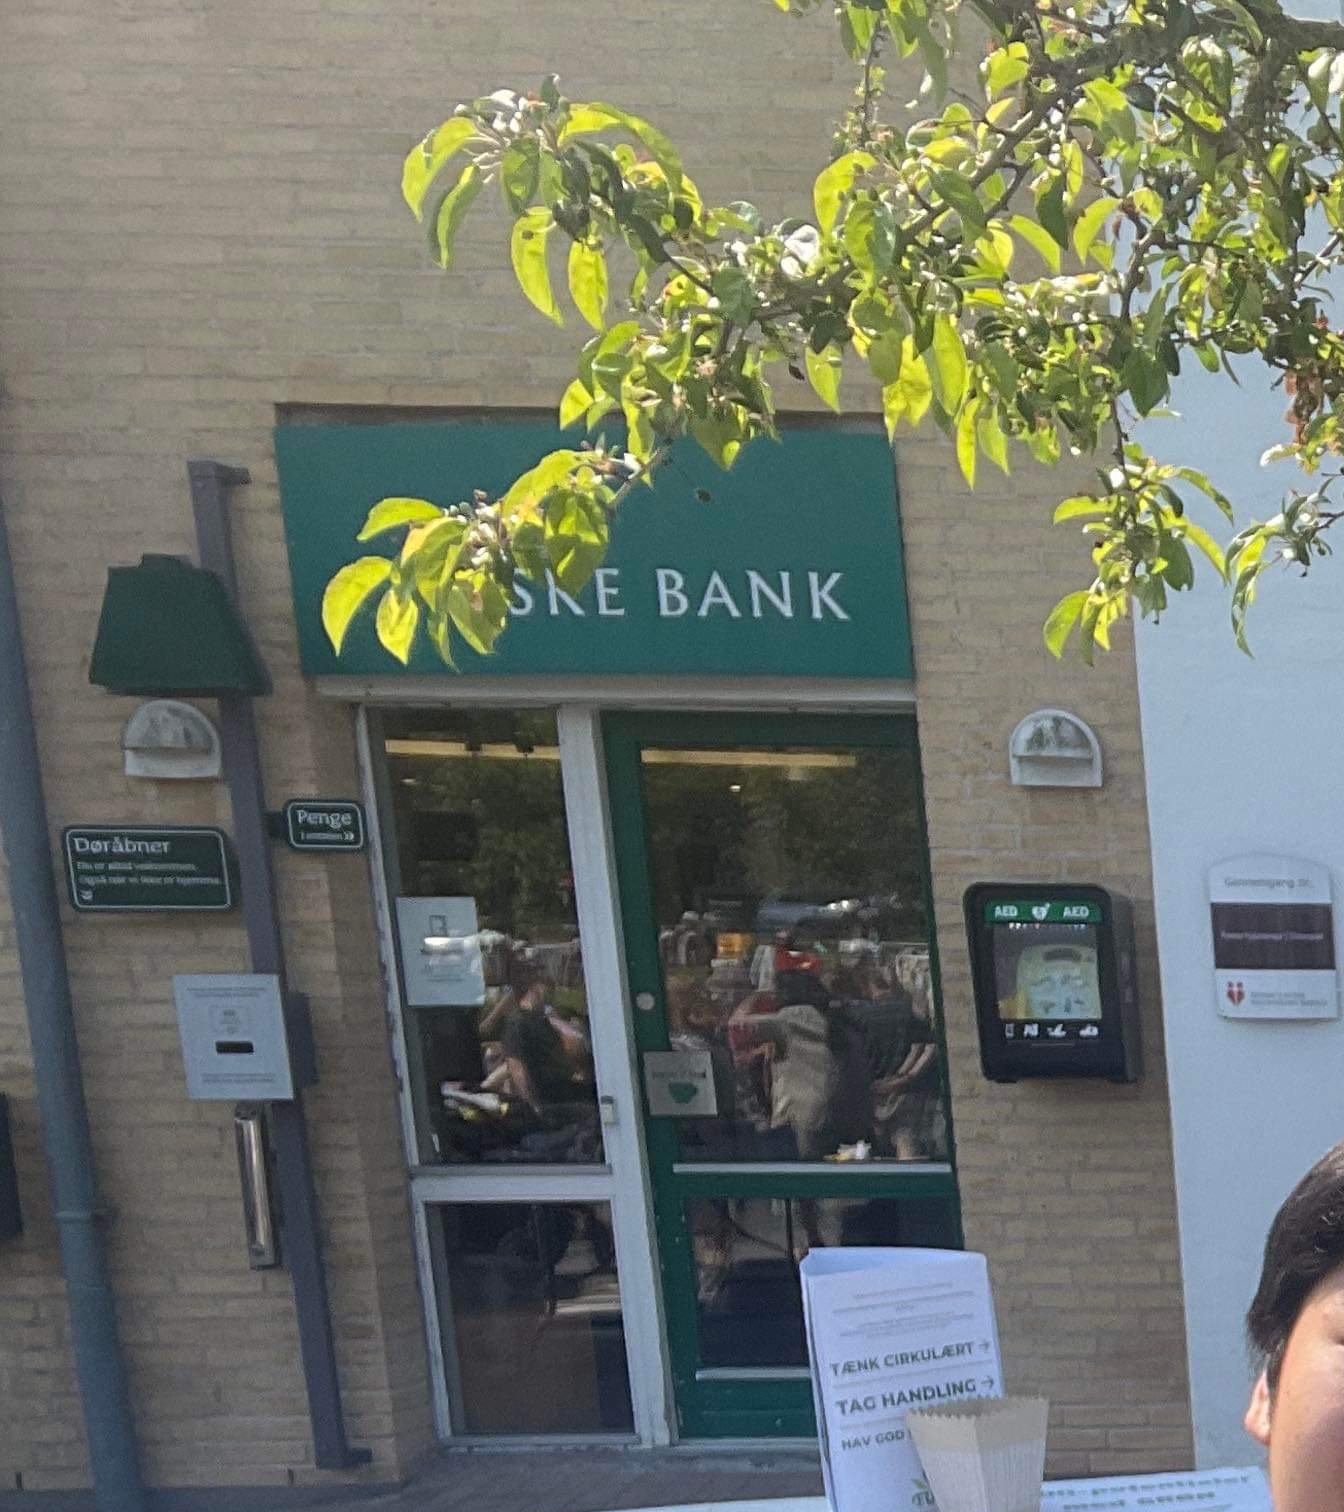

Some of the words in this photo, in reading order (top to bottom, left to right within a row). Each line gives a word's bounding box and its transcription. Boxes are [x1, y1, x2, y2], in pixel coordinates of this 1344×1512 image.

[509, 566, 626, 616] SKE
[655, 567, 850, 620] BANK
[297, 809, 353, 829] Penge
[73, 836, 170, 855] Døråbner
[994, 905, 1018, 918] AED
[1062, 906, 1089, 918] AED
[830, 1355, 880, 1377] TÆNK
[883, 1341, 975, 1368] CIRKULÆRT
[836, 1396, 877, 1415] TAG
[882, 1378, 977, 1409] HANDLING
[841, 1434, 871, 1451] HAV
